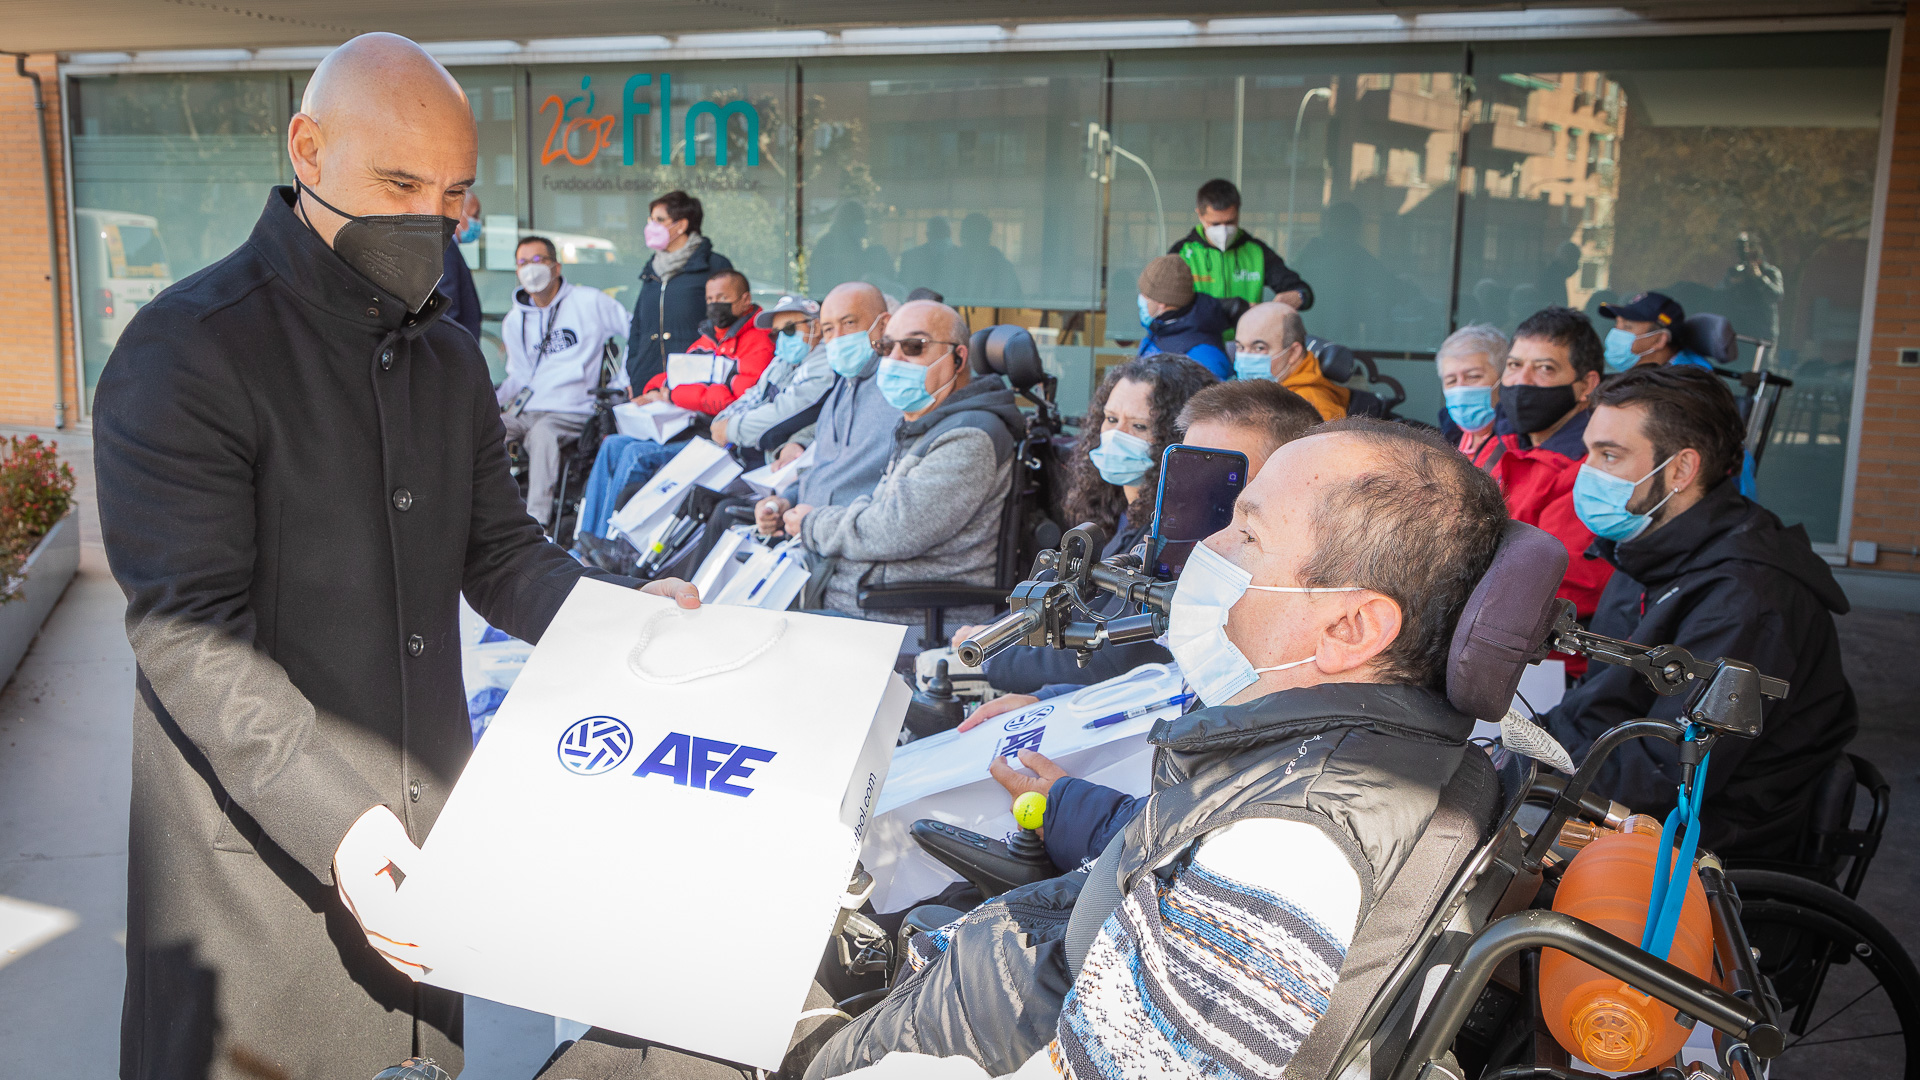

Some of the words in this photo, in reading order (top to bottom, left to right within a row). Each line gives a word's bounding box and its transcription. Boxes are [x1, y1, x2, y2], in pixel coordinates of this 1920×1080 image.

[623, 73, 759, 166] flm
[542, 174, 613, 191] Fundación
[616, 174, 693, 191] Lesionado
[696, 174, 760, 190] Medular
[632, 732, 778, 798] AFE
[852, 772, 877, 845] tbol.com
